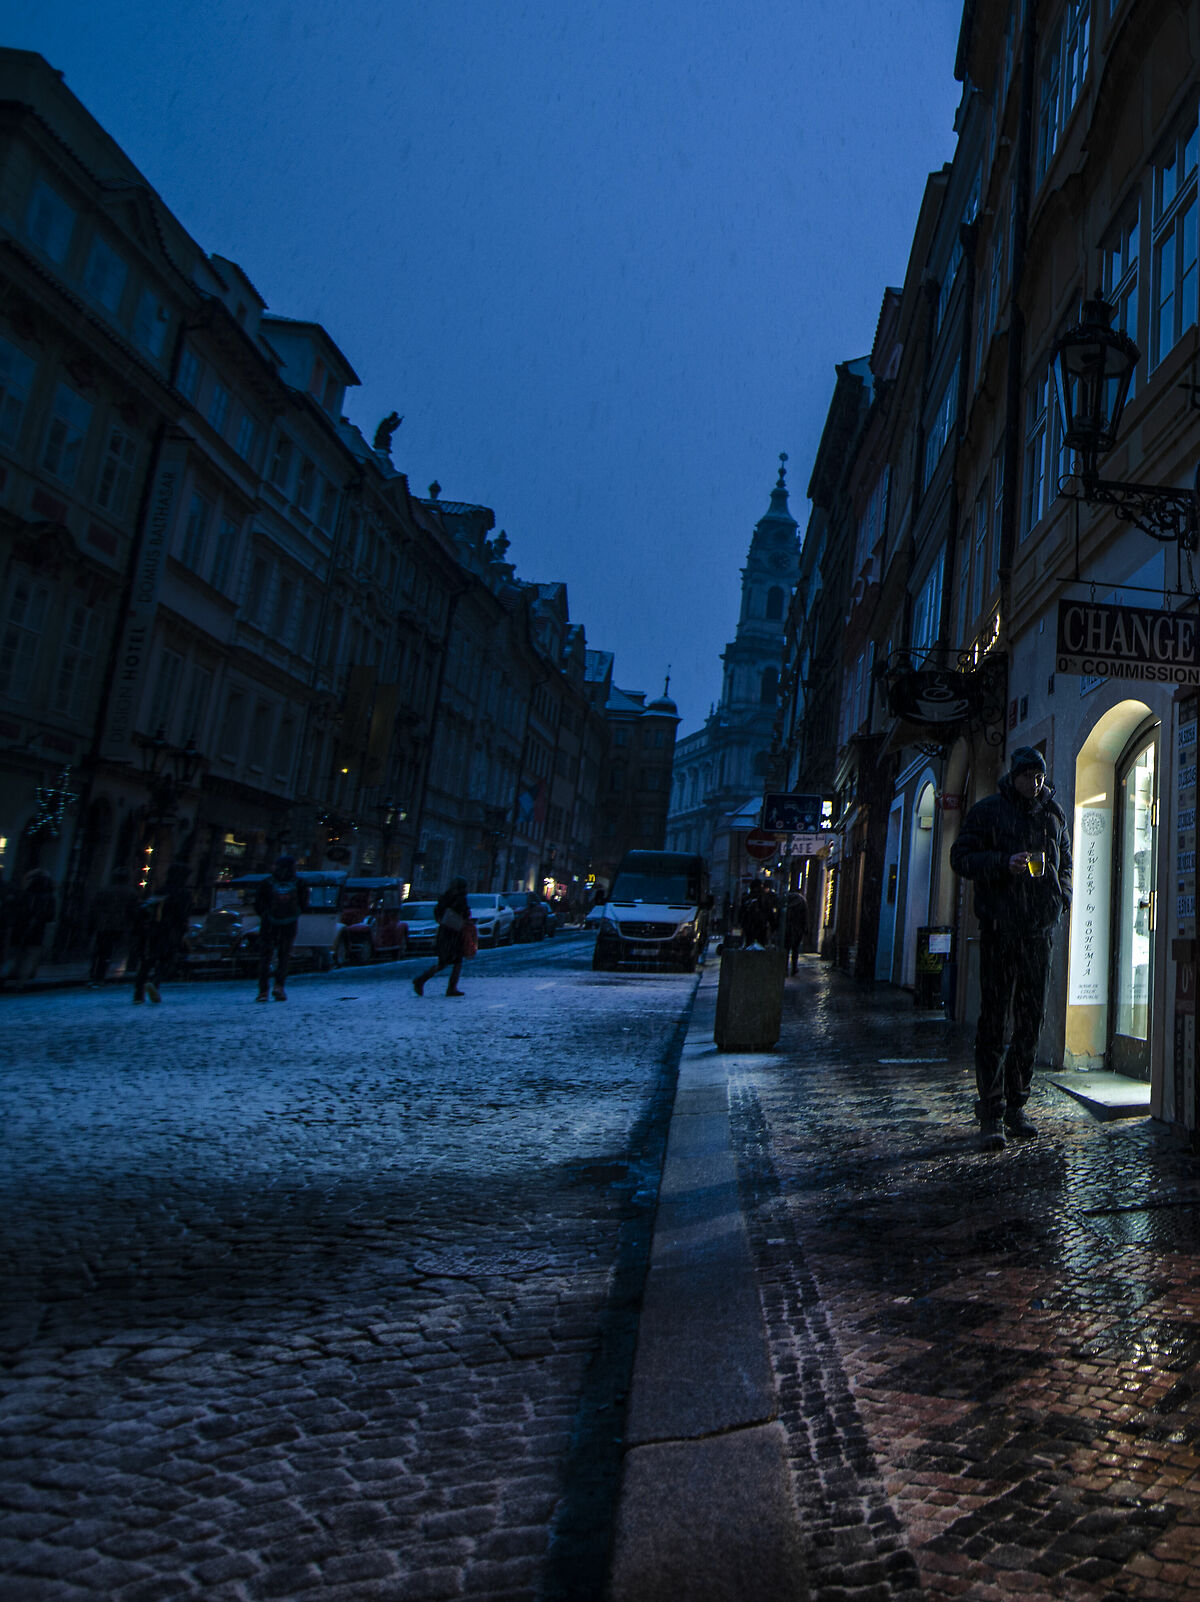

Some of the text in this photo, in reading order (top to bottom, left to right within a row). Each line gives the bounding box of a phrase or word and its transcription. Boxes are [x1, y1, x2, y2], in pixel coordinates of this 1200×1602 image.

[123, 629, 145, 680] HOTEL
[136, 549, 161, 603] DOMUS
[149, 471, 177, 545] BALTHASAR
[1064, 606, 1195, 662] CHANGE
[1082, 660, 1200, 683] COMMISSION
[1083, 842, 1099, 977] JEWELRY by BOHEMIA
